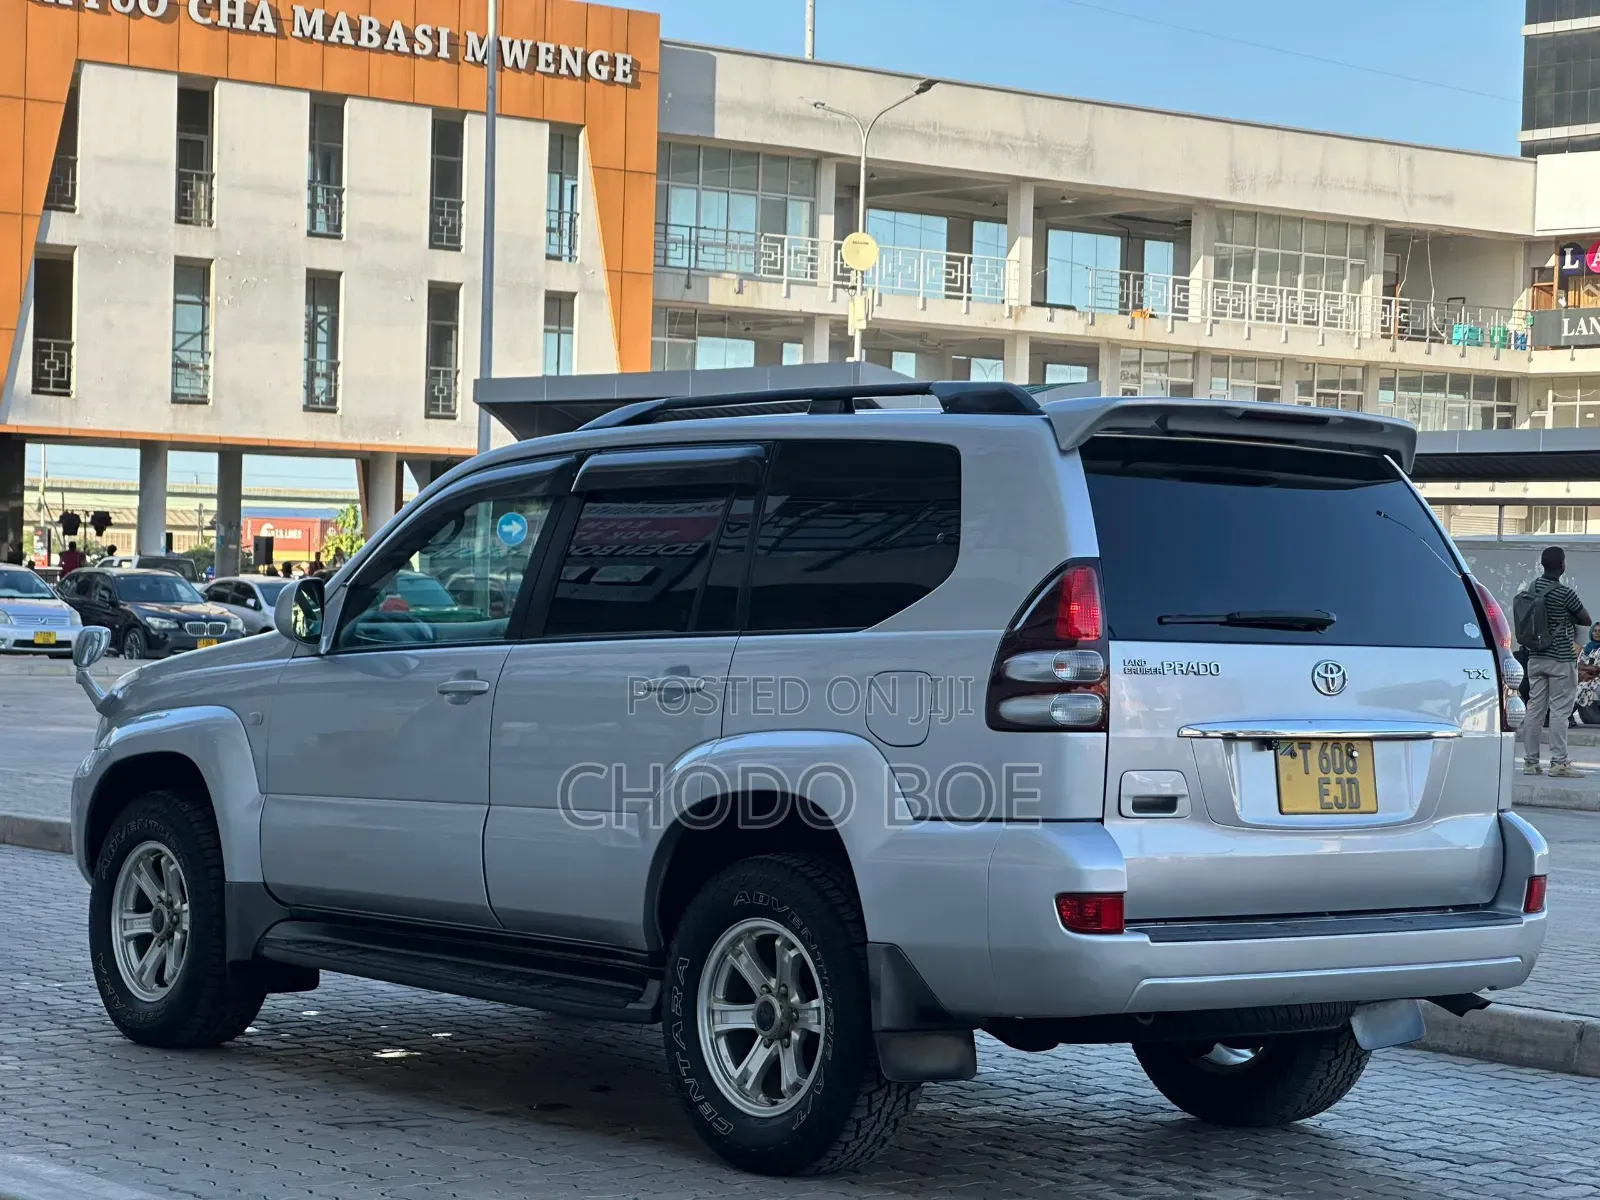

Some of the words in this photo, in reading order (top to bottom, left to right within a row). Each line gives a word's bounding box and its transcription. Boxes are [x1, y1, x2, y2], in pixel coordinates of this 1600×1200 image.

[187, 0, 277, 33] CHA
[292, 4, 450, 59] MABASI
[464, 30, 633, 84] MWENGE
[1122, 659, 1147, 667] LAND
[1123, 667, 1162, 675] CRUISER
[1161, 661, 1221, 676] PRADO
[1463, 668, 1490, 680] TX
[1298, 742, 1312, 775] T
[1318, 742, 1358, 775] 608
[1317, 777, 1361, 810] EJD
[671, 957, 734, 1136] CENTARA
